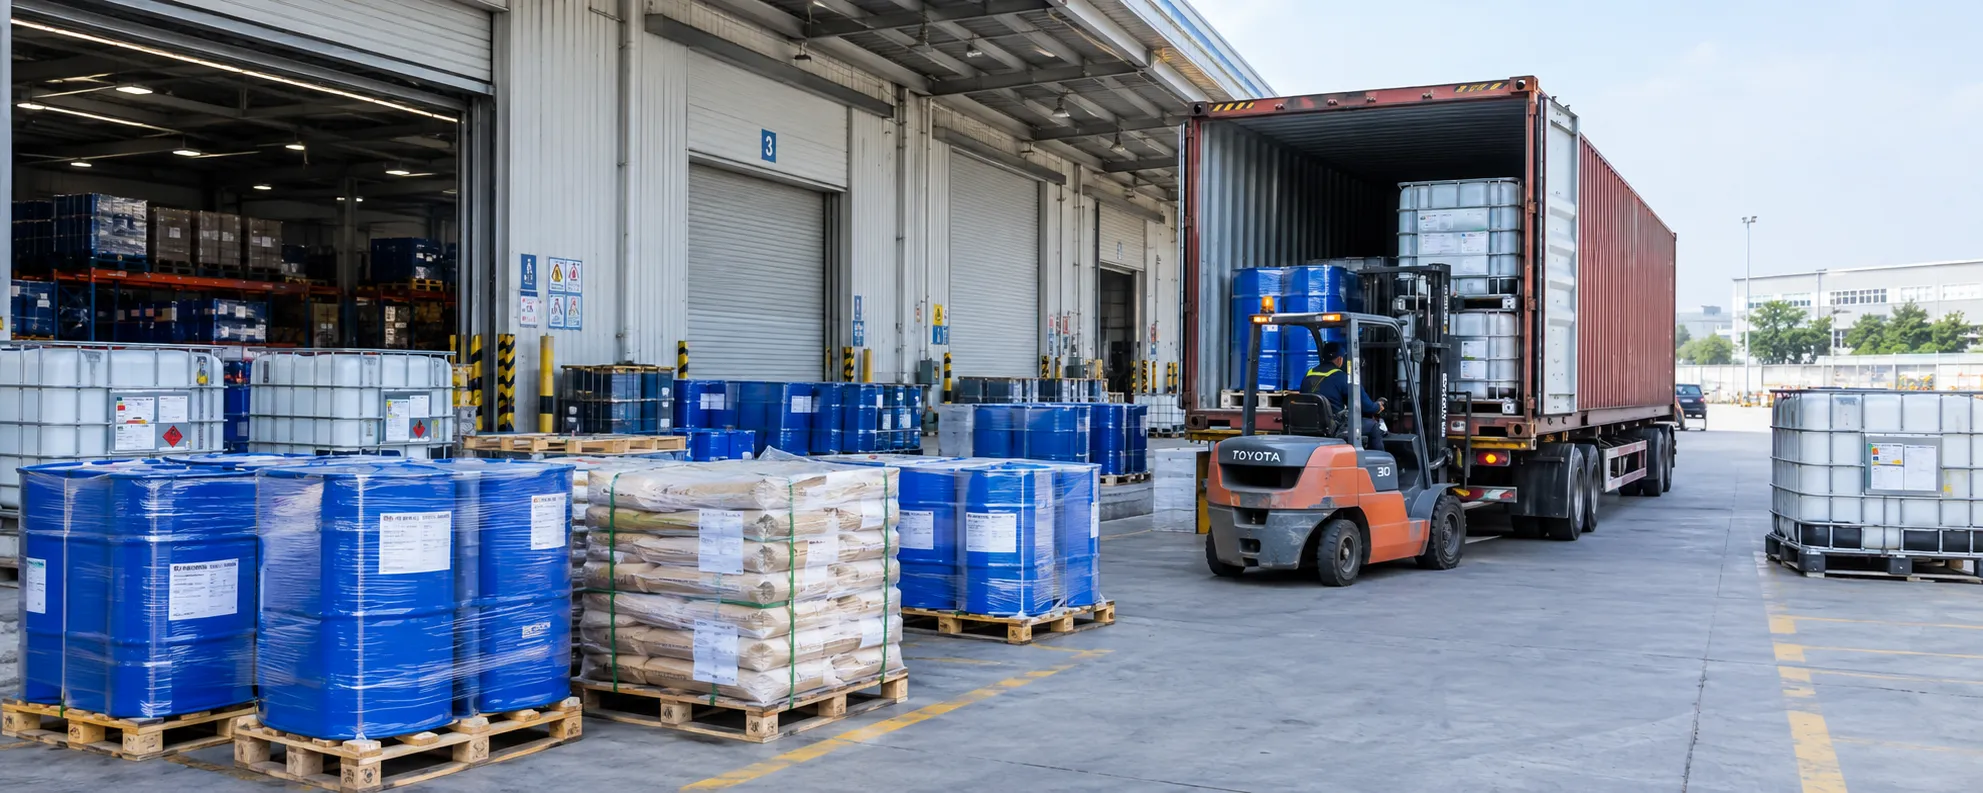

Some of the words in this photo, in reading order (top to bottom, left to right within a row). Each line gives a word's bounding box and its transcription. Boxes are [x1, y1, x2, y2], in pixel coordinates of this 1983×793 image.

[766, 136, 773, 156] 3
[1232, 450, 1281, 462] TOYOTA
[1377, 466, 1391, 477] 30
